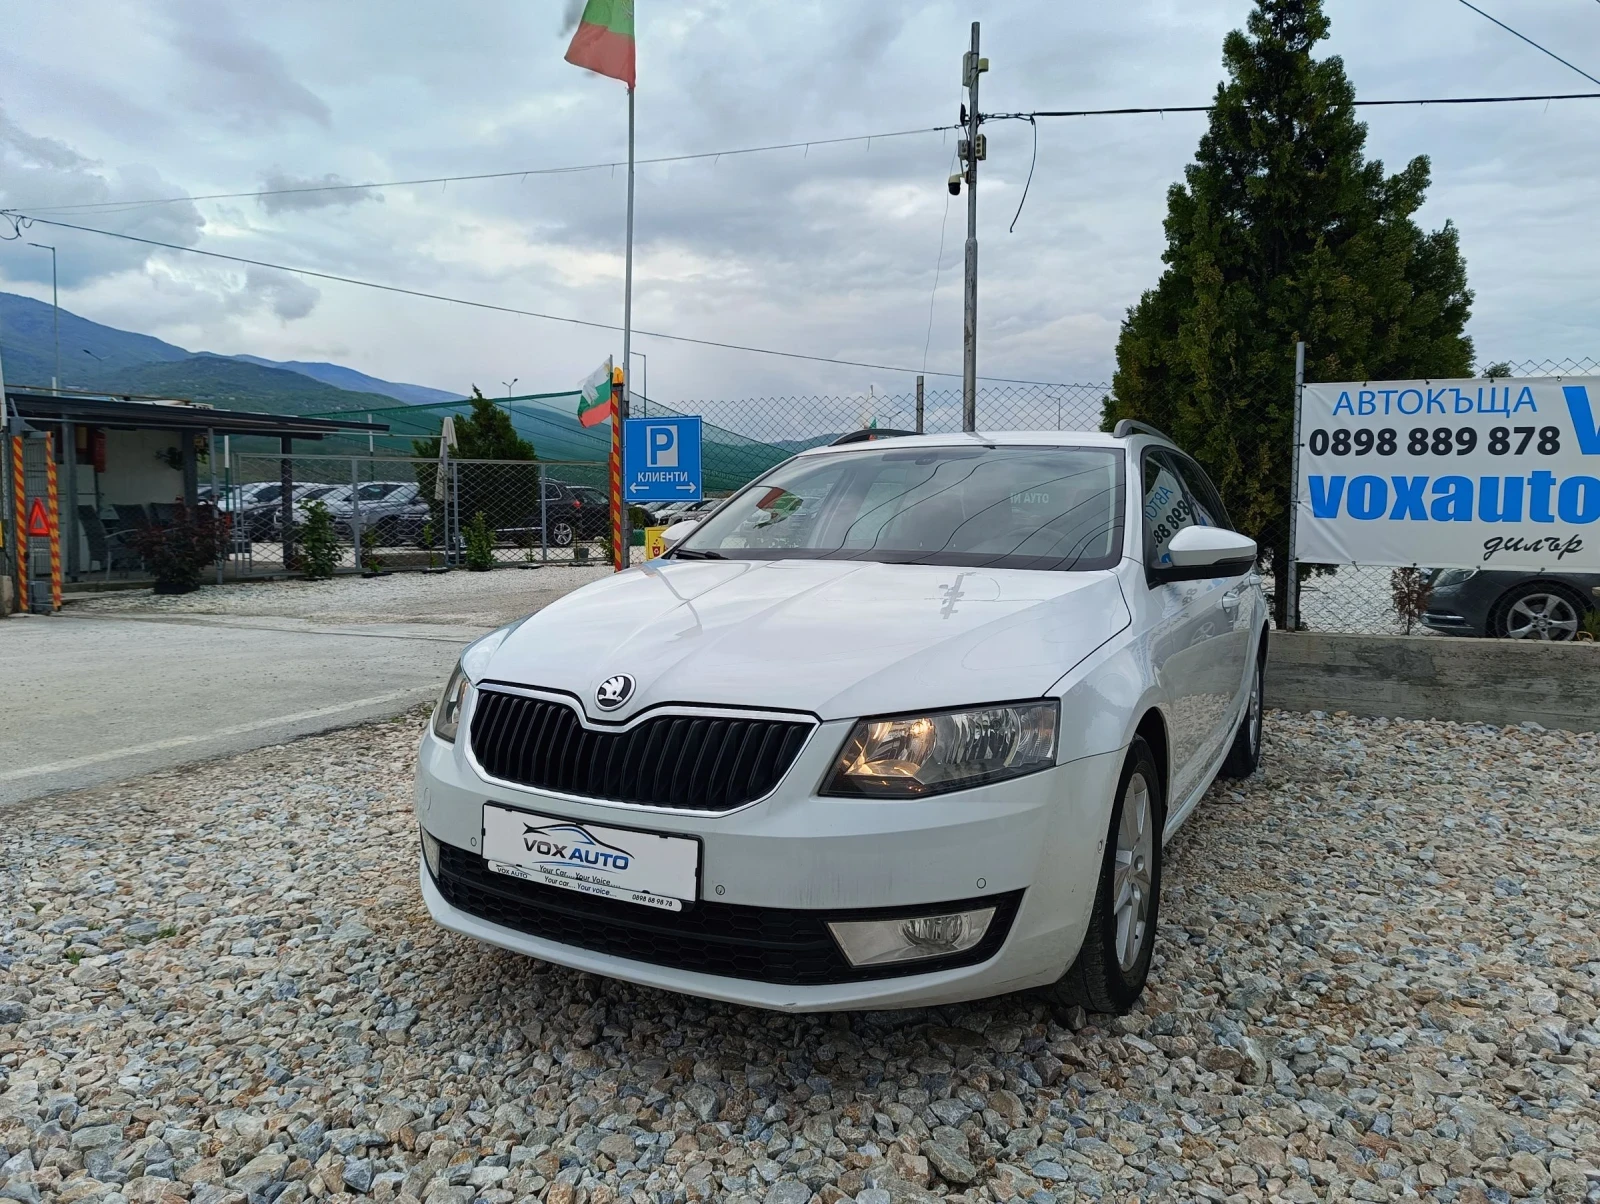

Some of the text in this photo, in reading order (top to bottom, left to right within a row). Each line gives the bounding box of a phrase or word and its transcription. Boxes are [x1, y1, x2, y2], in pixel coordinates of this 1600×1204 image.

[1332, 386, 1537, 418] АВТОКЪЩА
[650, 427, 674, 465] P
[1309, 426, 1561, 456] 0898 889 878
[637, 471, 688, 482] КЛИЕНТИ
[1308, 470, 1600, 524] voxauto
[1483, 534, 1584, 561] дилър
[523, 837, 629, 870] VOX AUTO
[497, 867, 528, 879] VOX AUTO
[539, 864, 554, 874] Your
[544, 875, 558, 885] Your
[577, 882, 591, 892] Your
